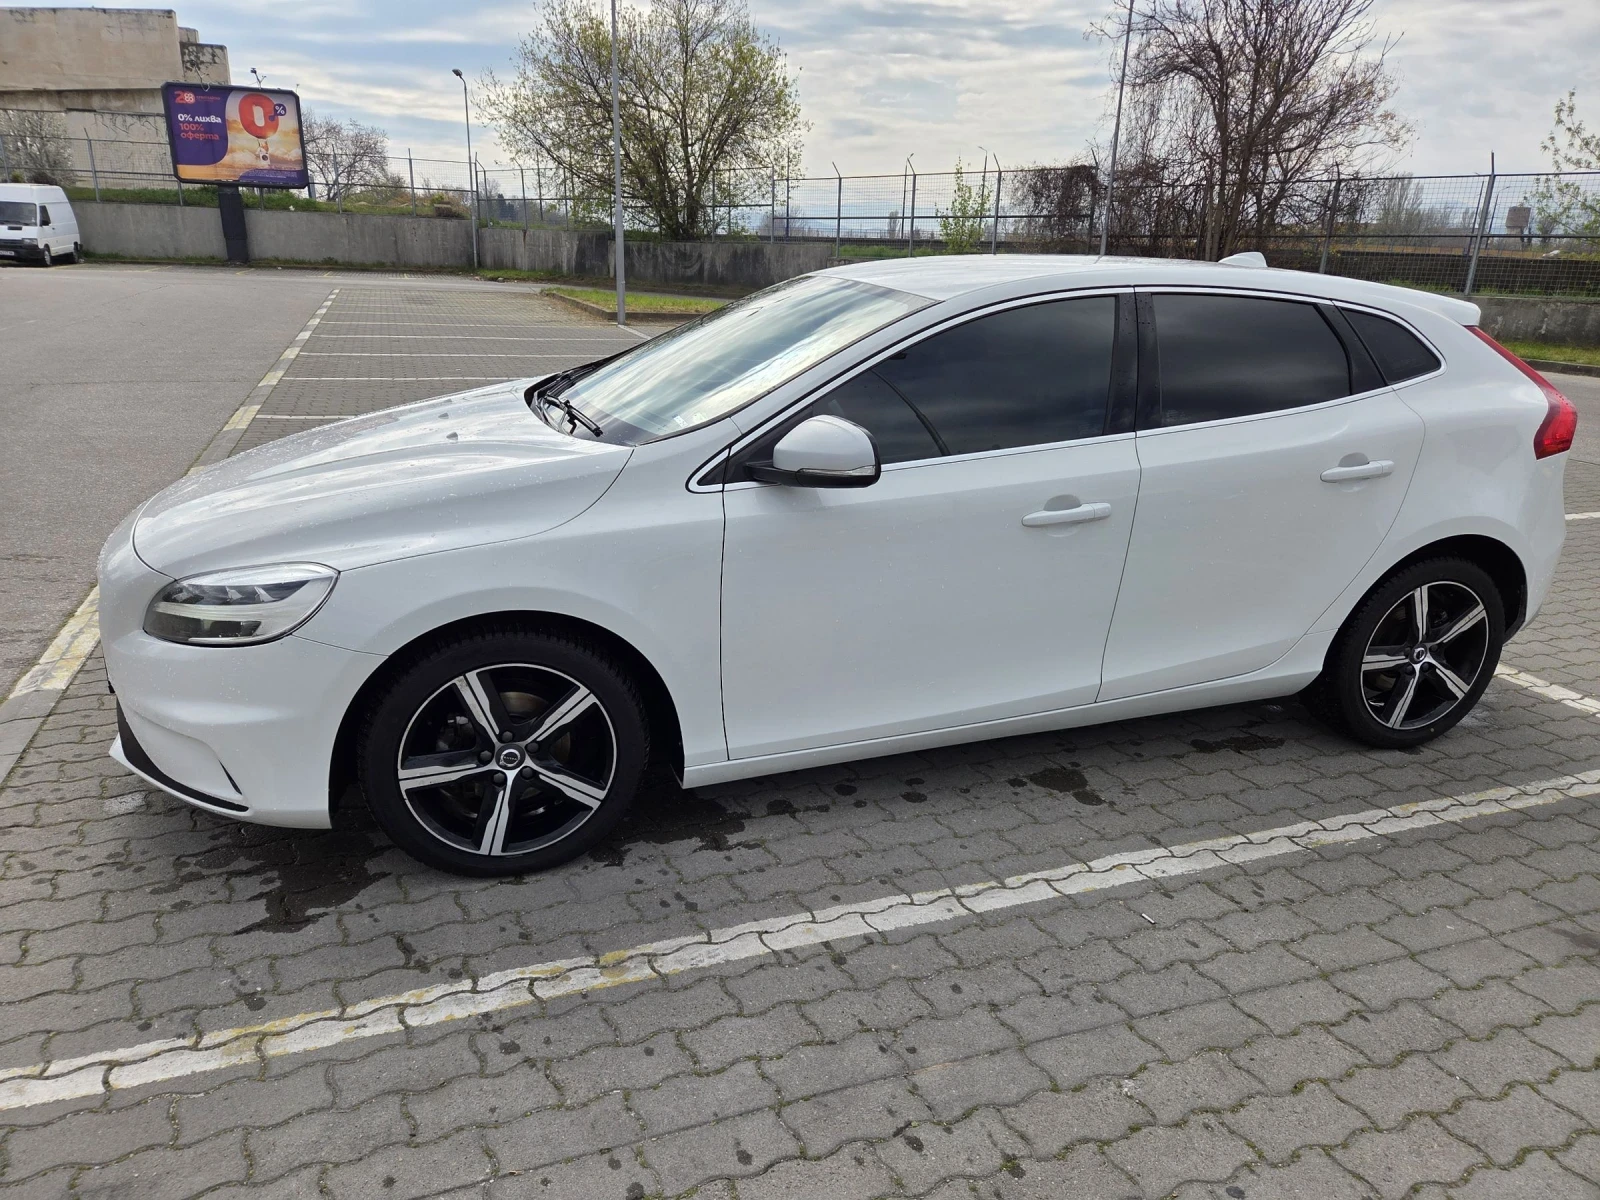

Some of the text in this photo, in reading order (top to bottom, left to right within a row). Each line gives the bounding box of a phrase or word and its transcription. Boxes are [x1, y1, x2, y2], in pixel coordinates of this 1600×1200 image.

[178, 113, 222, 124] 0% лихва
[179, 123, 205, 131] 100%
[180, 131, 220, 141] оферта
